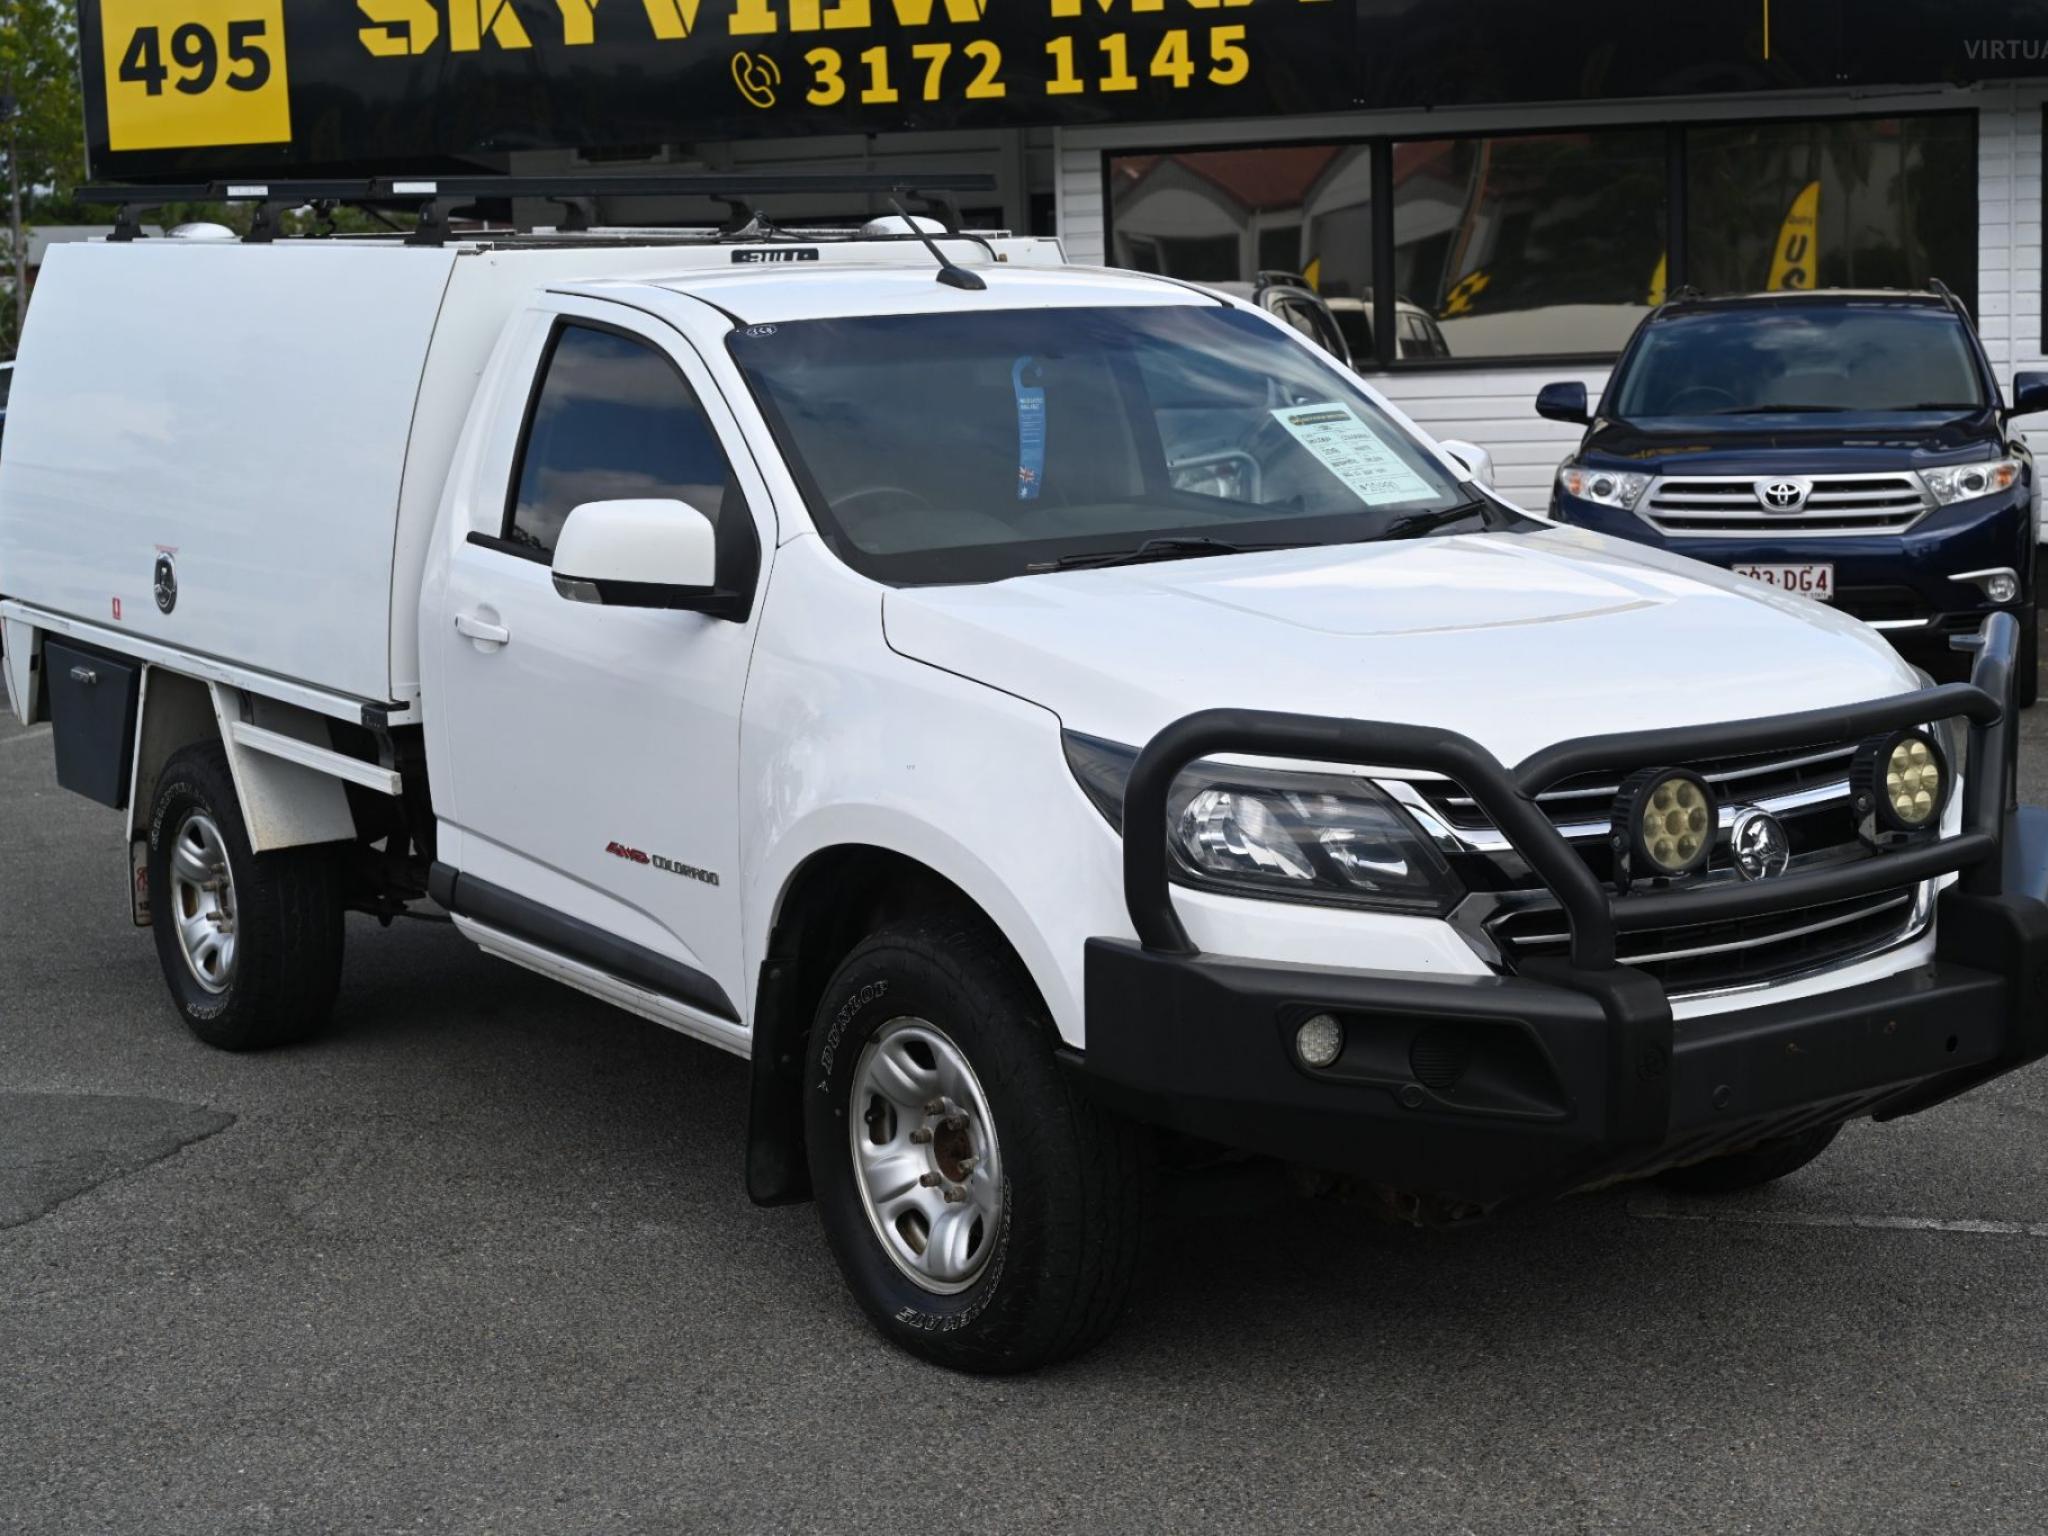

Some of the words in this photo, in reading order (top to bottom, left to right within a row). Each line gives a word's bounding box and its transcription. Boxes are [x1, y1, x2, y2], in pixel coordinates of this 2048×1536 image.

[118, 19, 271, 96] 495
[804, 40, 1006, 106] 3172
[1045, 24, 1250, 94] 1145
[652, 853, 720, 886] COLORADO
[820, 979, 889, 1076] DUNLOP
